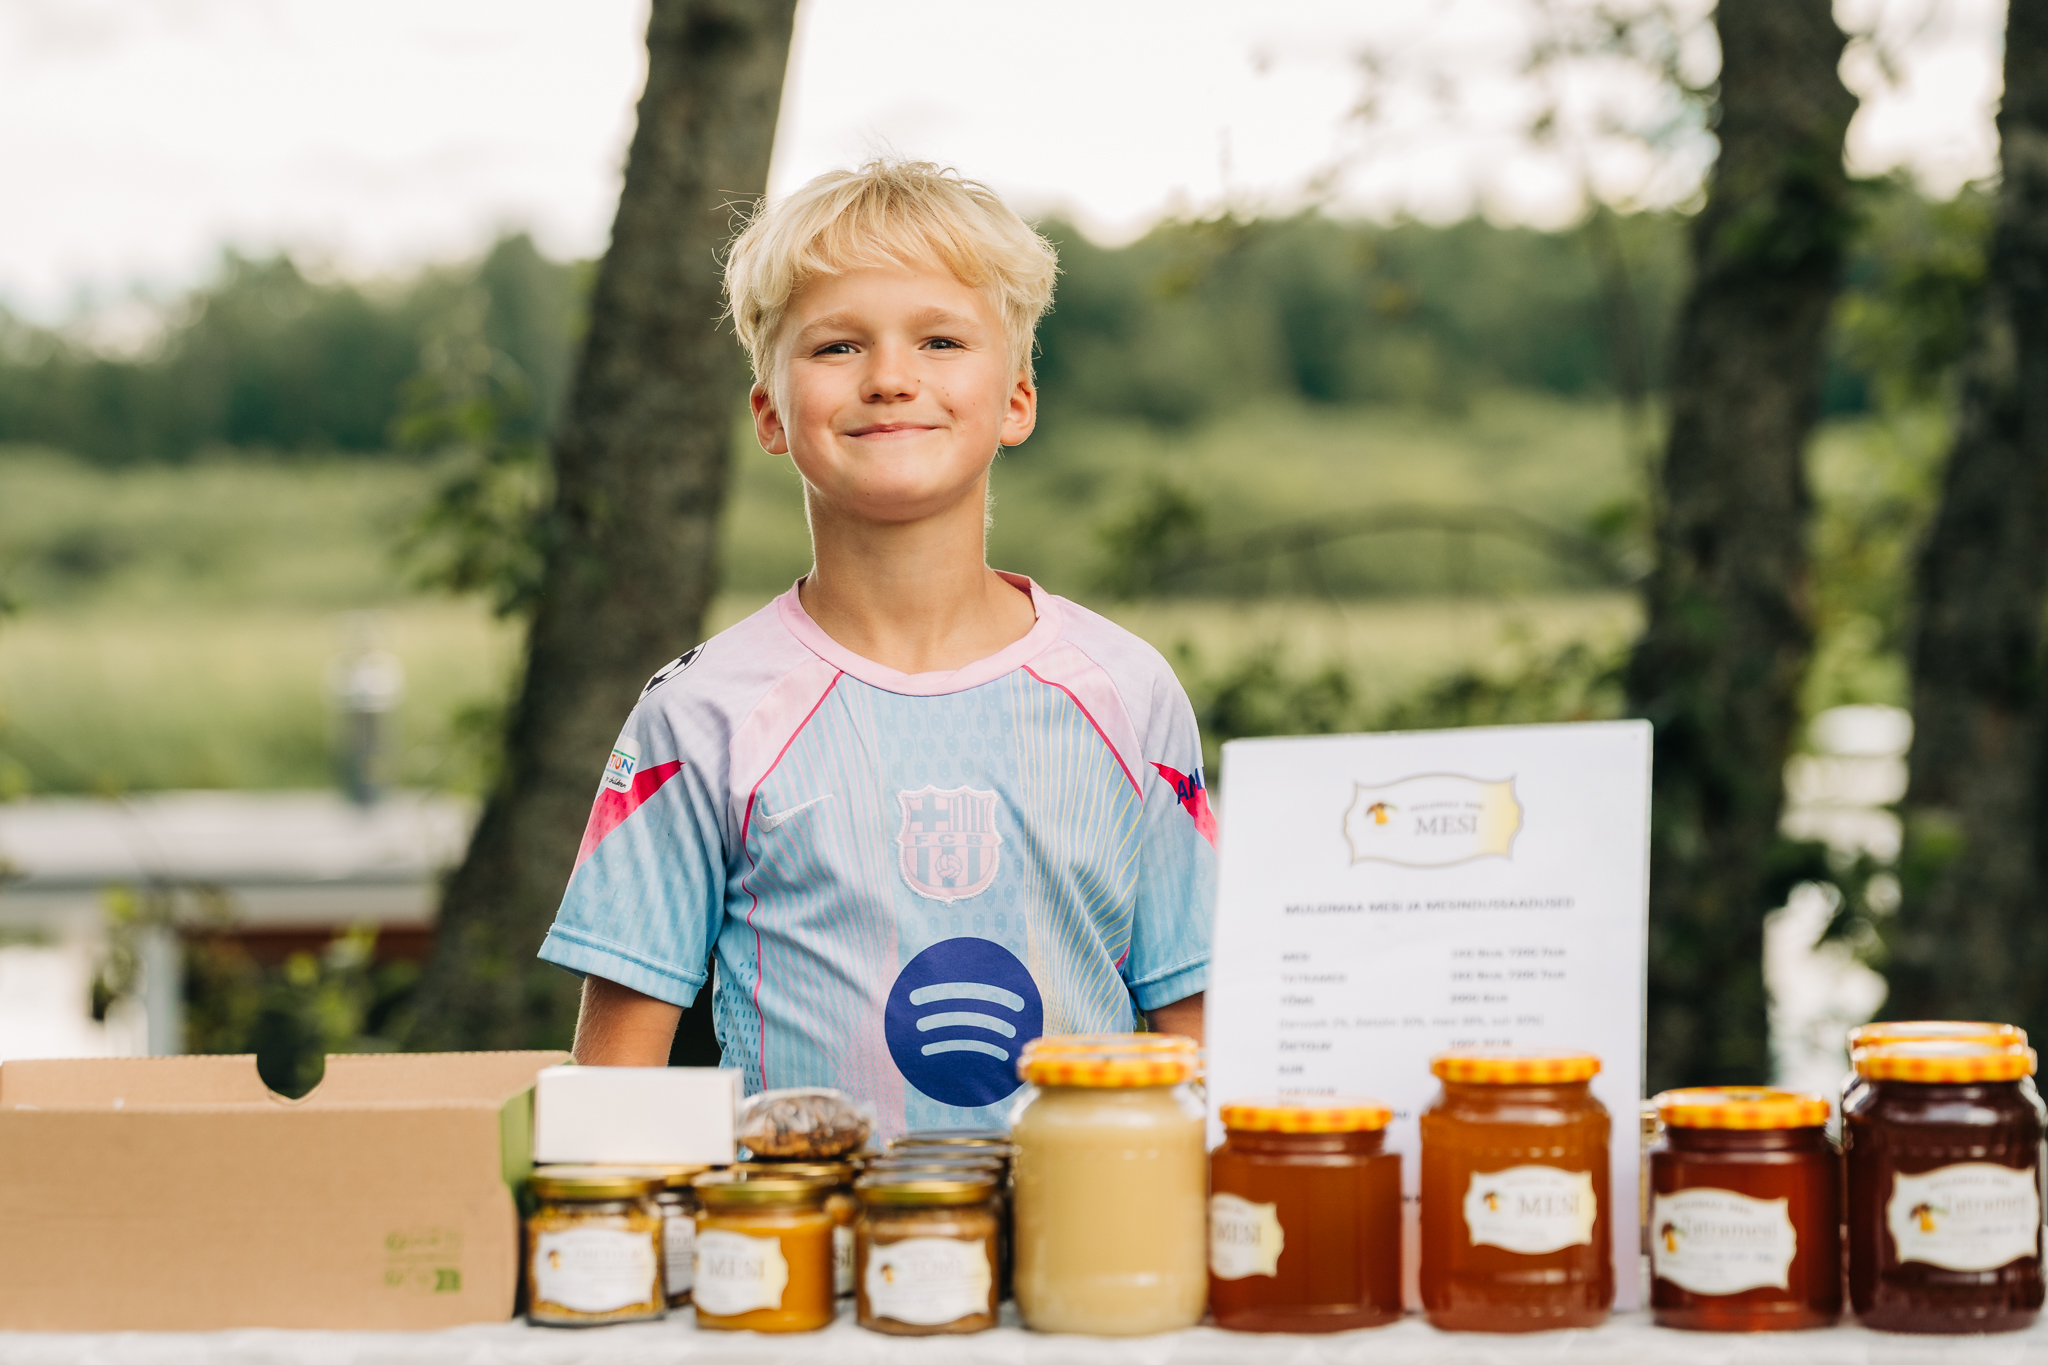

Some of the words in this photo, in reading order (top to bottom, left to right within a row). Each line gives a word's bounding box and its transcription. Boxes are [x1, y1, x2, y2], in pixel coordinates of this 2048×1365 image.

[611, 753, 634, 775] TION
[1415, 814, 1478, 836] MESI
[914, 833, 984, 846] FCB
[1368, 901, 1404, 914] MESI
[1518, 1193, 1581, 1218] MESI
[1216, 1222, 1262, 1246] MESI
[709, 1255, 765, 1281] MESI
